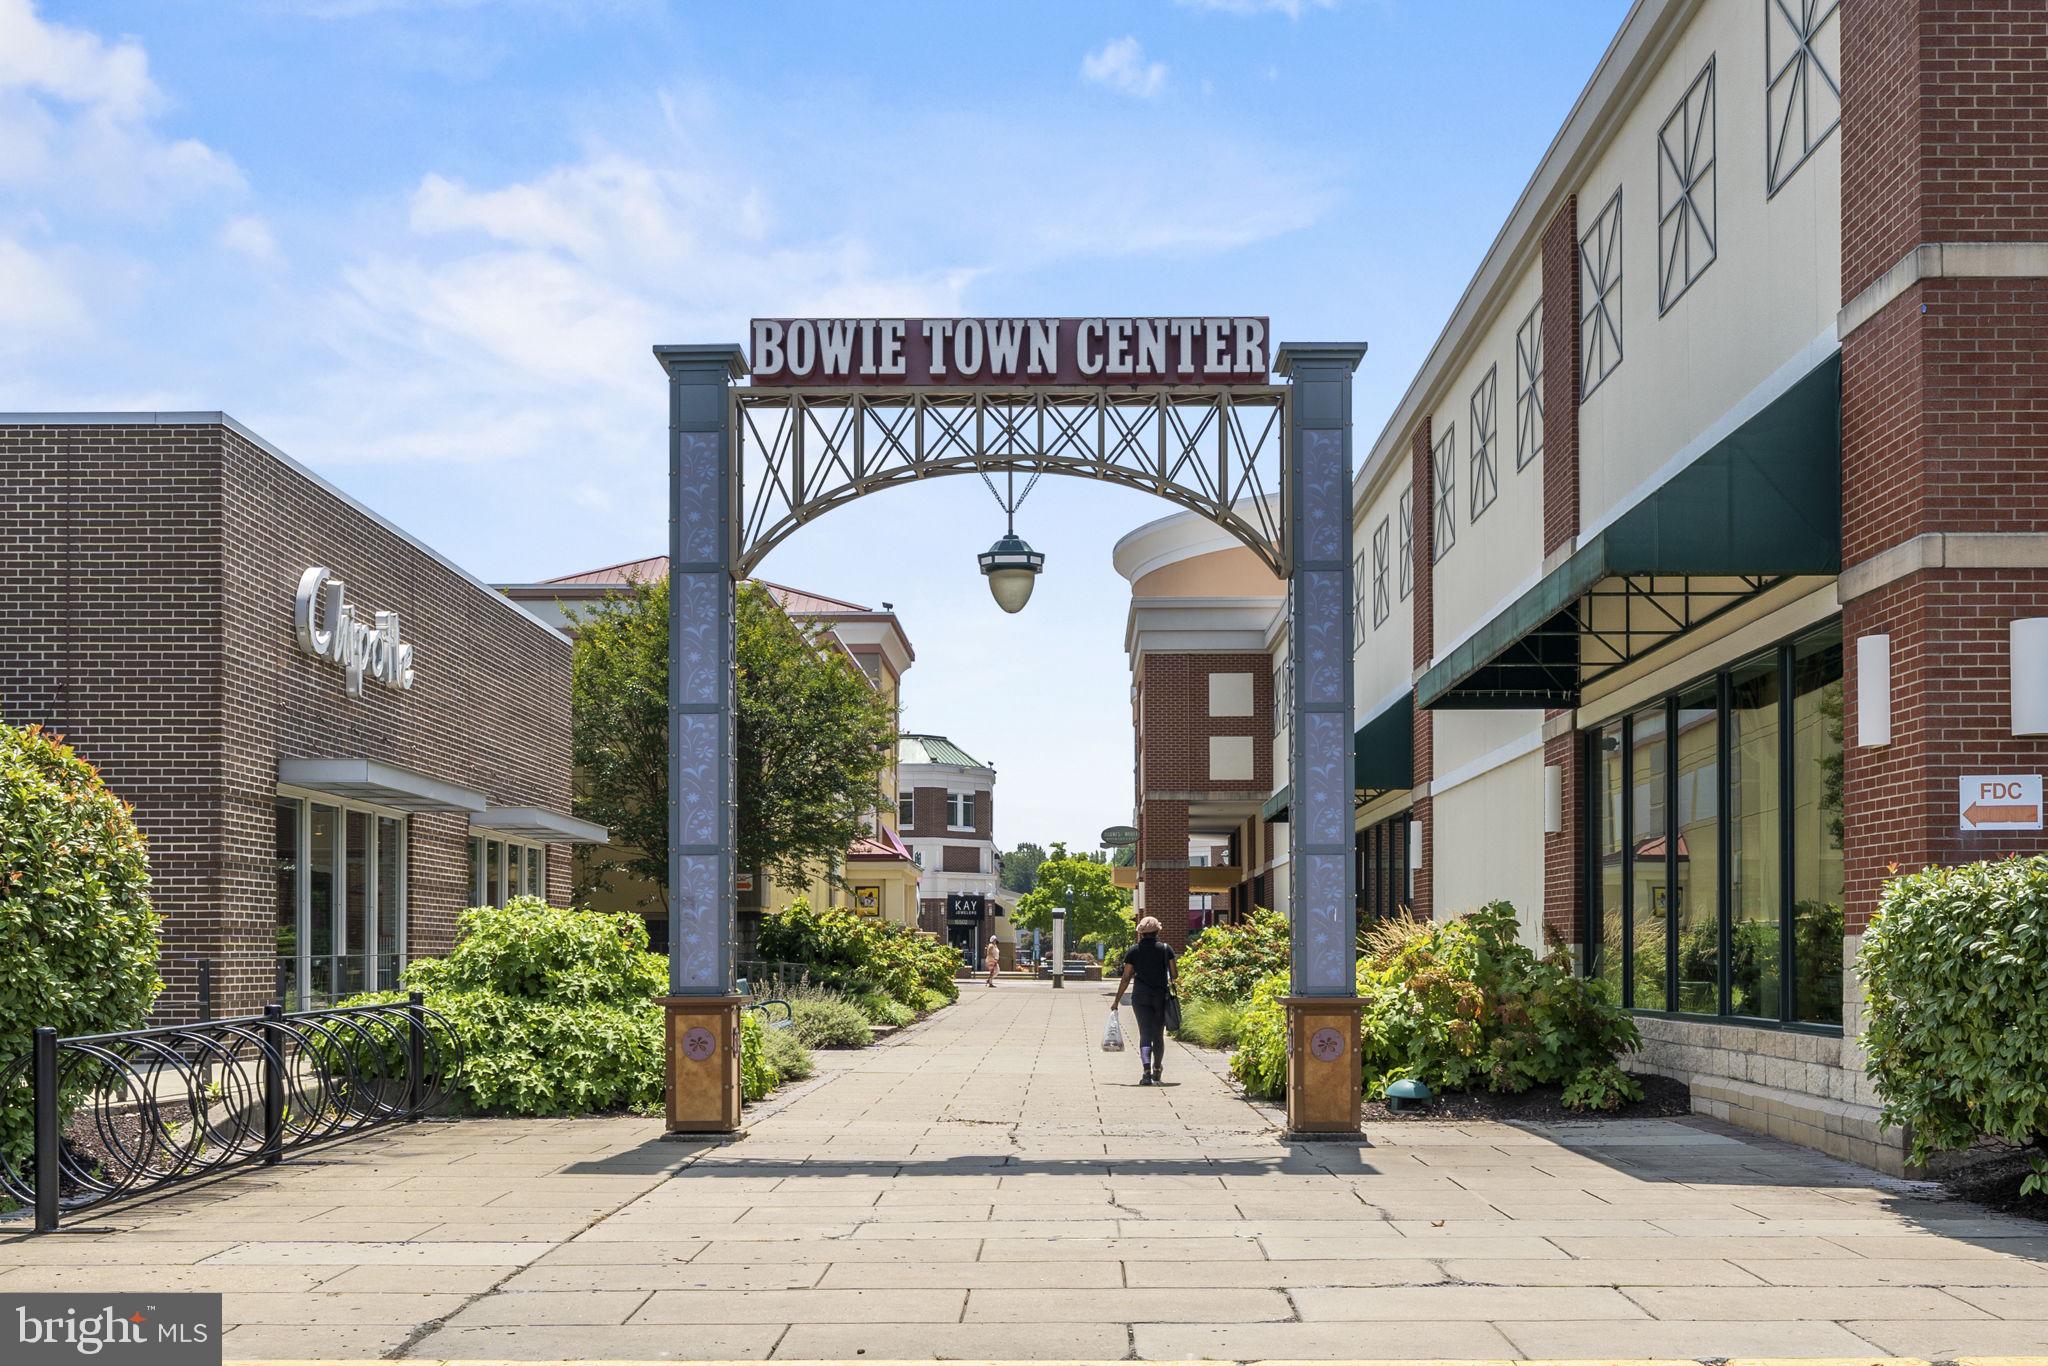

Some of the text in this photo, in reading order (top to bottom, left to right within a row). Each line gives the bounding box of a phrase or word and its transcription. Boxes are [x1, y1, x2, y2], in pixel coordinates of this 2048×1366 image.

[752, 317, 1266, 375] BOWIE TOWN CENTER
[294, 566, 415, 698] Chipotle
[1980, 782, 2023, 800] FDC
[955, 900, 977, 910] KAY
